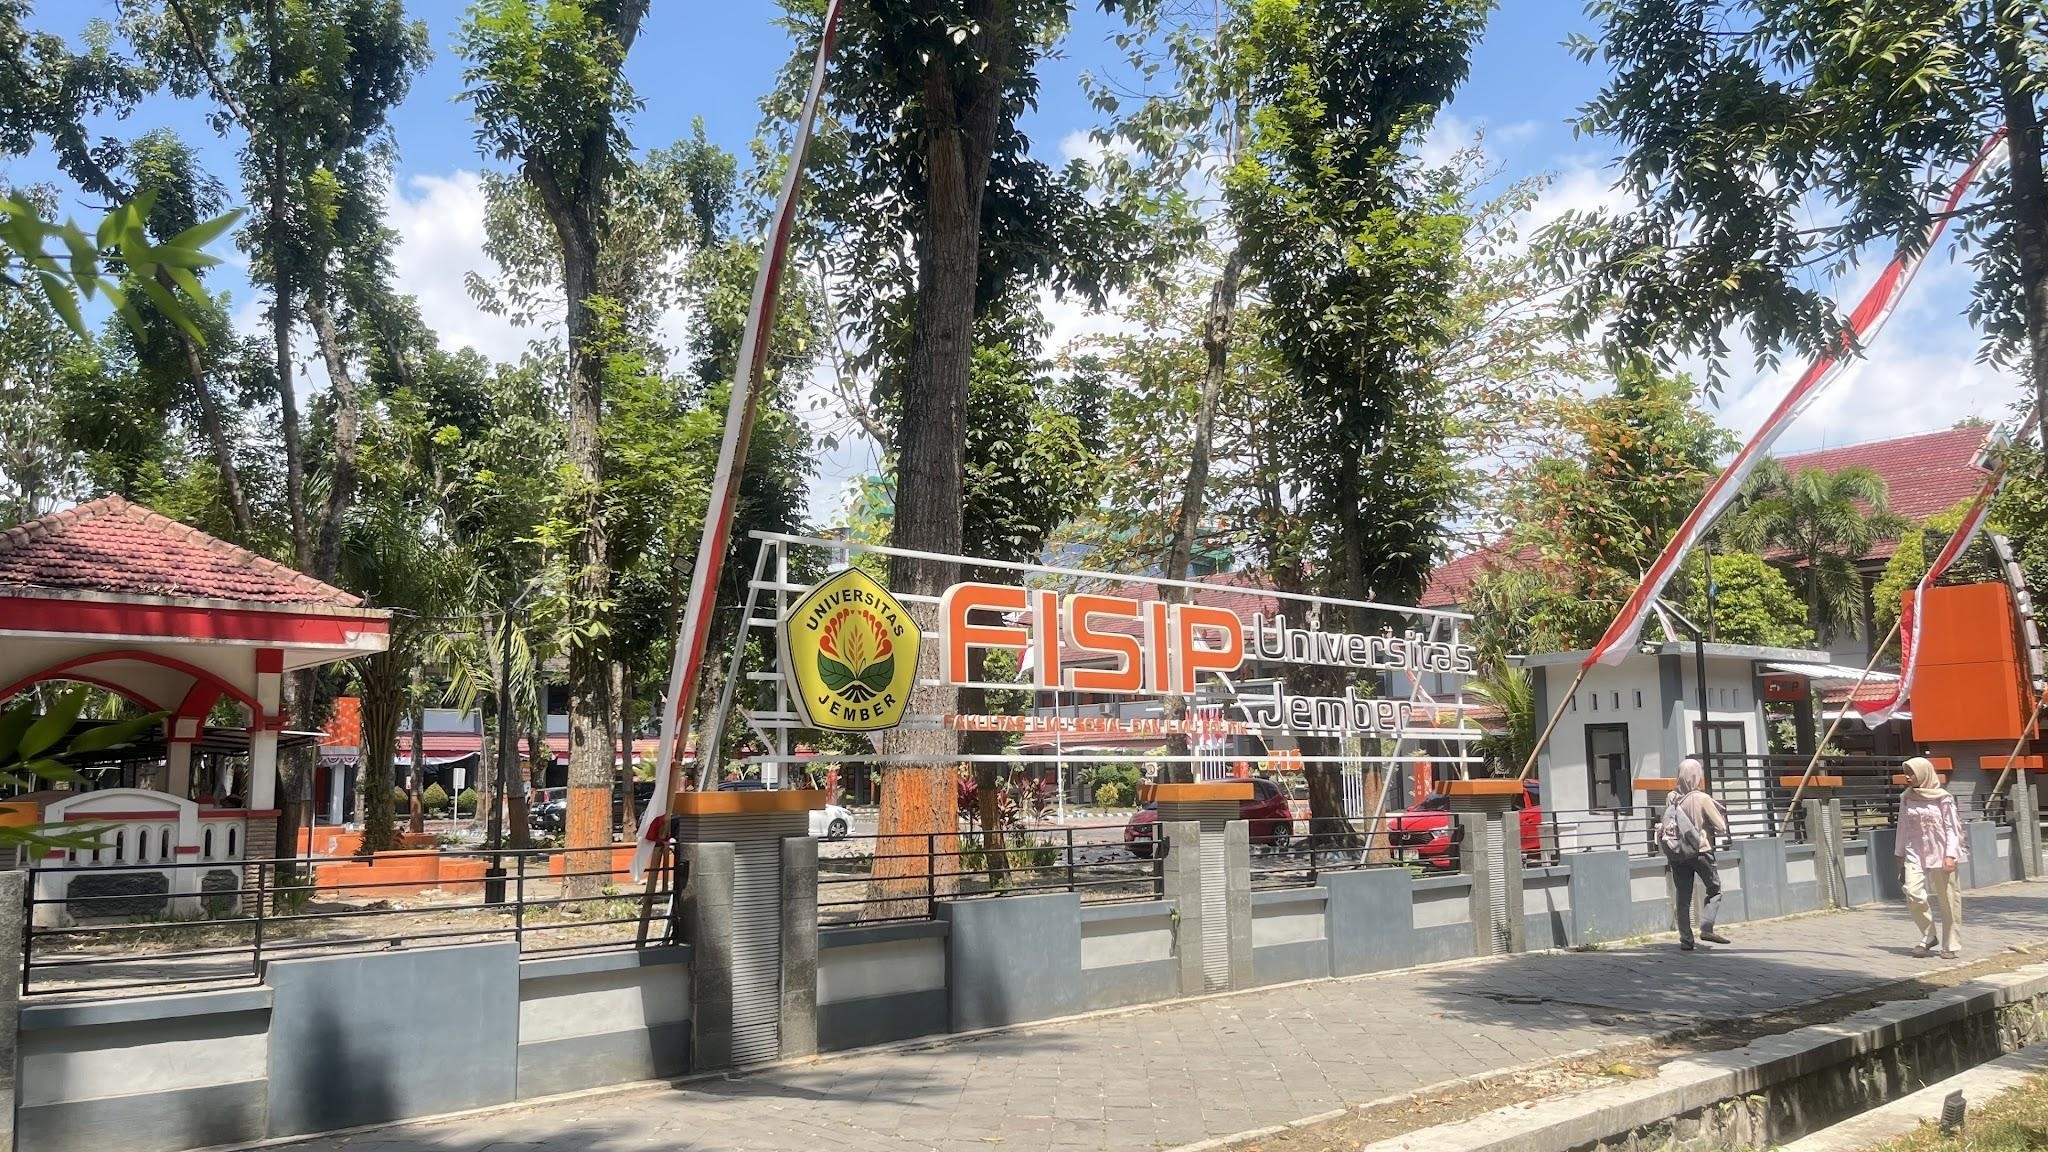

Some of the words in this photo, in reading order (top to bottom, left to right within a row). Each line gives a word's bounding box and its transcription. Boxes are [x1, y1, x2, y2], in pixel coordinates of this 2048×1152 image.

[806, 589, 904, 637] UNIVERSITAS
[939, 582, 1244, 696] FISIP
[1253, 612, 1473, 673] Universitas
[818, 693, 896, 722] JEMBER
[943, 714, 1025, 731] FAKULTAS
[1073, 717, 1127, 733] SOSIAL
[1130, 718, 1161, 733] DAN
[1257, 681, 1412, 731] Jember
